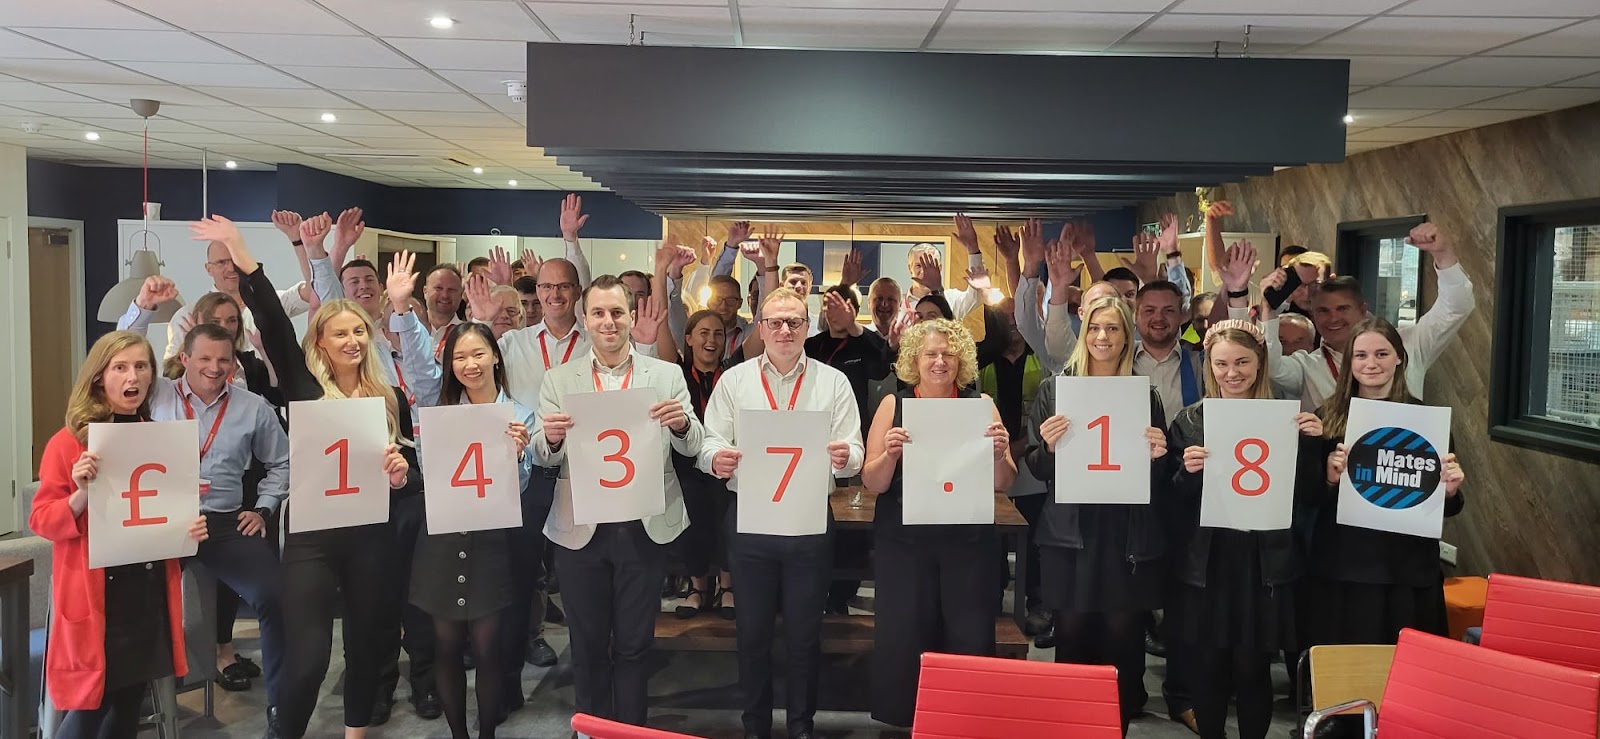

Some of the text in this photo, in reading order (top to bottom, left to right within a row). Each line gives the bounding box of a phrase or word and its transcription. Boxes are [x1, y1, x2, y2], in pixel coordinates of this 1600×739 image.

[324, 438, 360, 497] 1
[450, 441, 494, 499] 4
[597, 428, 637, 489] 3
[1087, 415, 1121, 472] 1
[1231, 438, 1271, 497] 8
[1377, 448, 1436, 472] Mates
[120, 462, 168, 528] £
[765, 446, 804, 503] 7
[1355, 463, 1422, 488] in Mind
